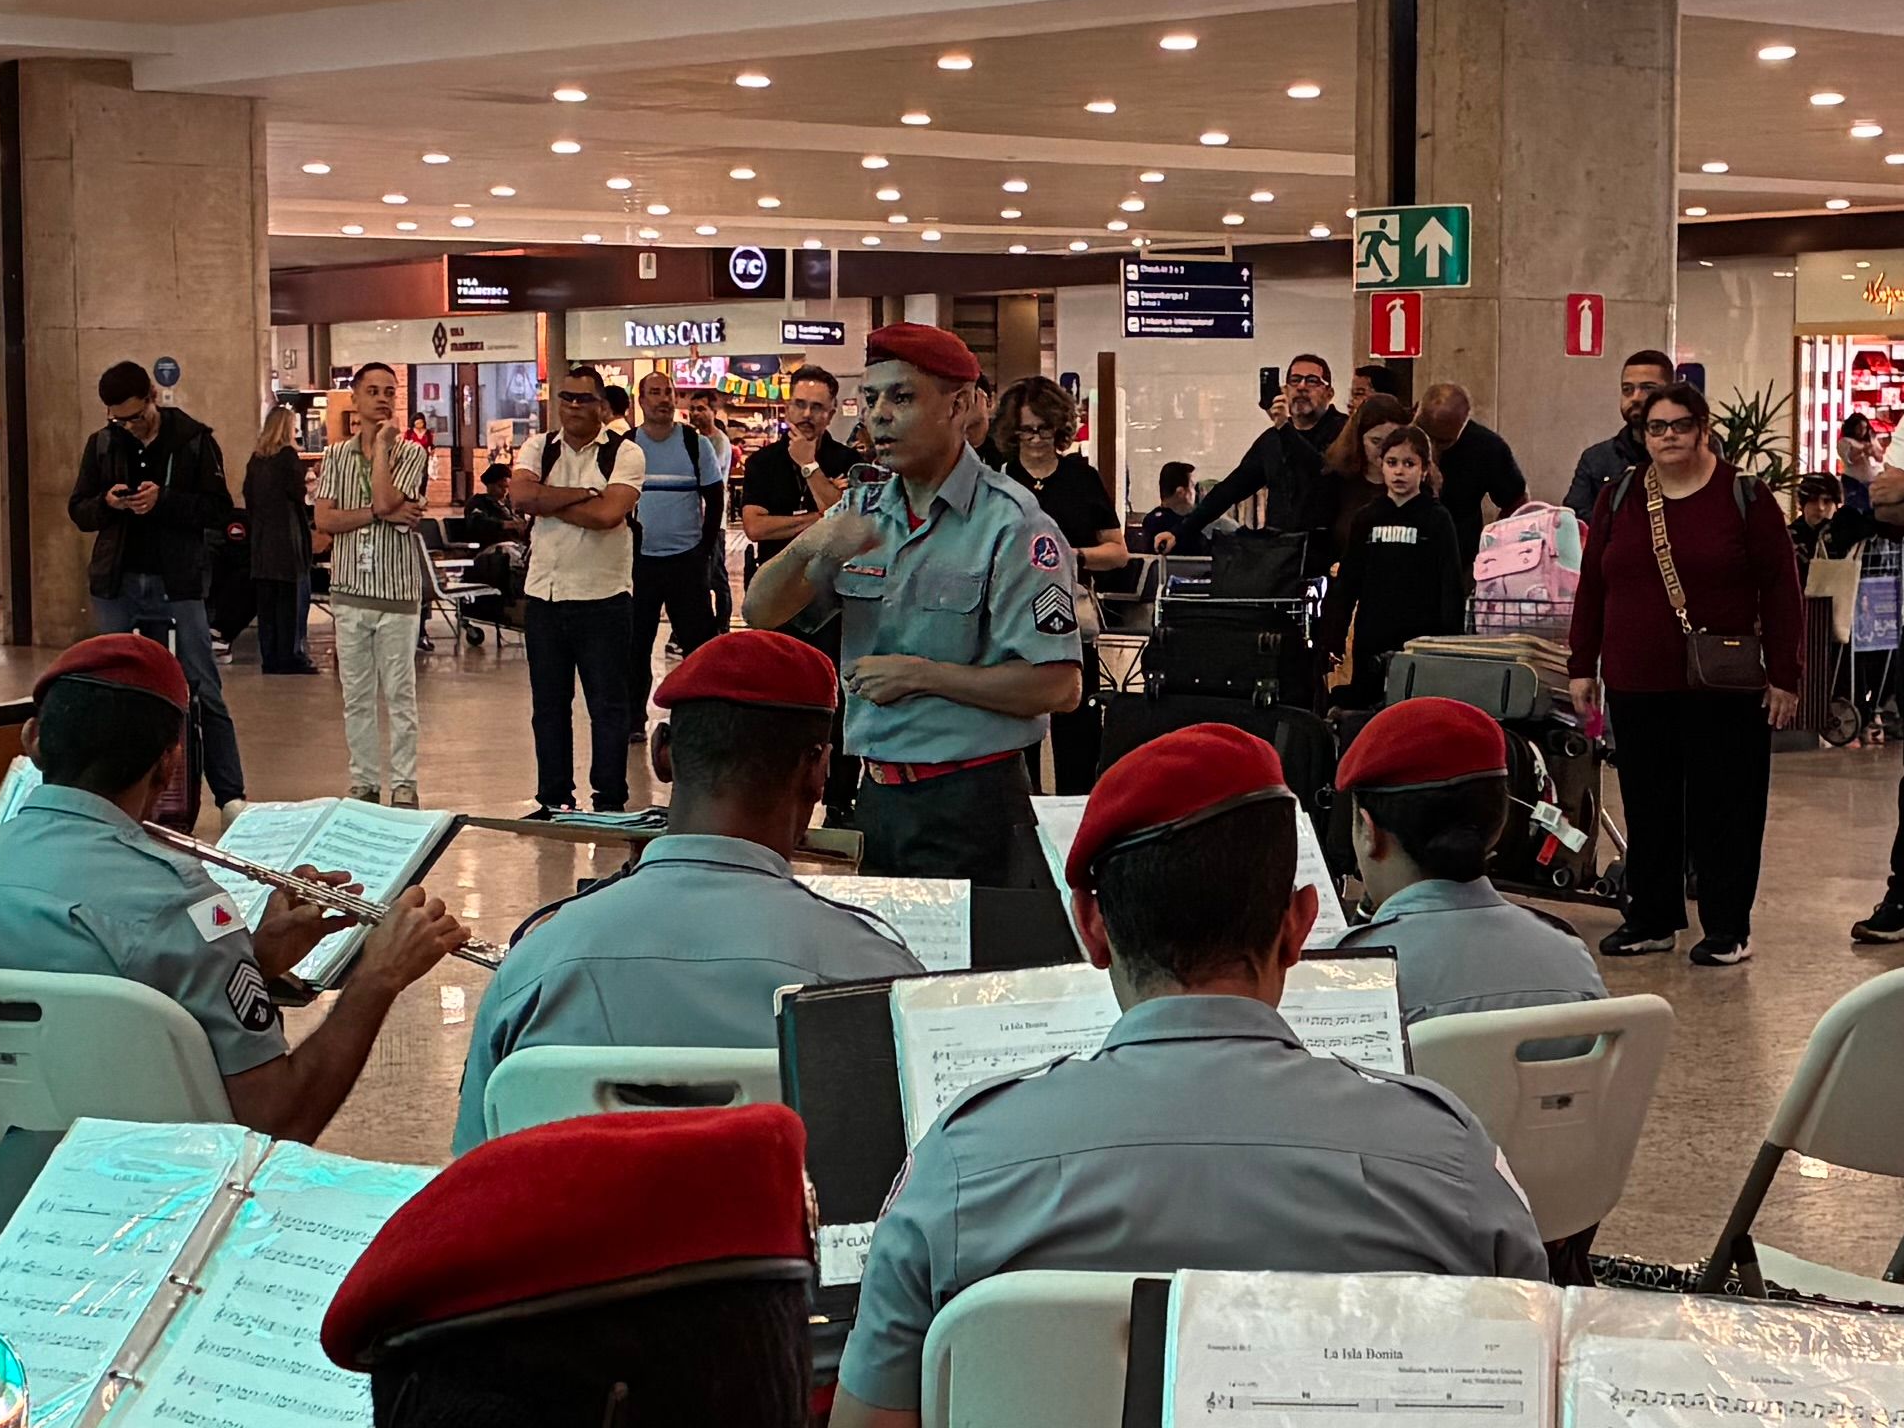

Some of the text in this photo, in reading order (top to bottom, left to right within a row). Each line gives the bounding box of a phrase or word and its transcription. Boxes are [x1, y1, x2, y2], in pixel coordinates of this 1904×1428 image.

[1372, 526, 1417, 544] PUMA
[1324, 1347, 1404, 1360] La Isla Bonita
